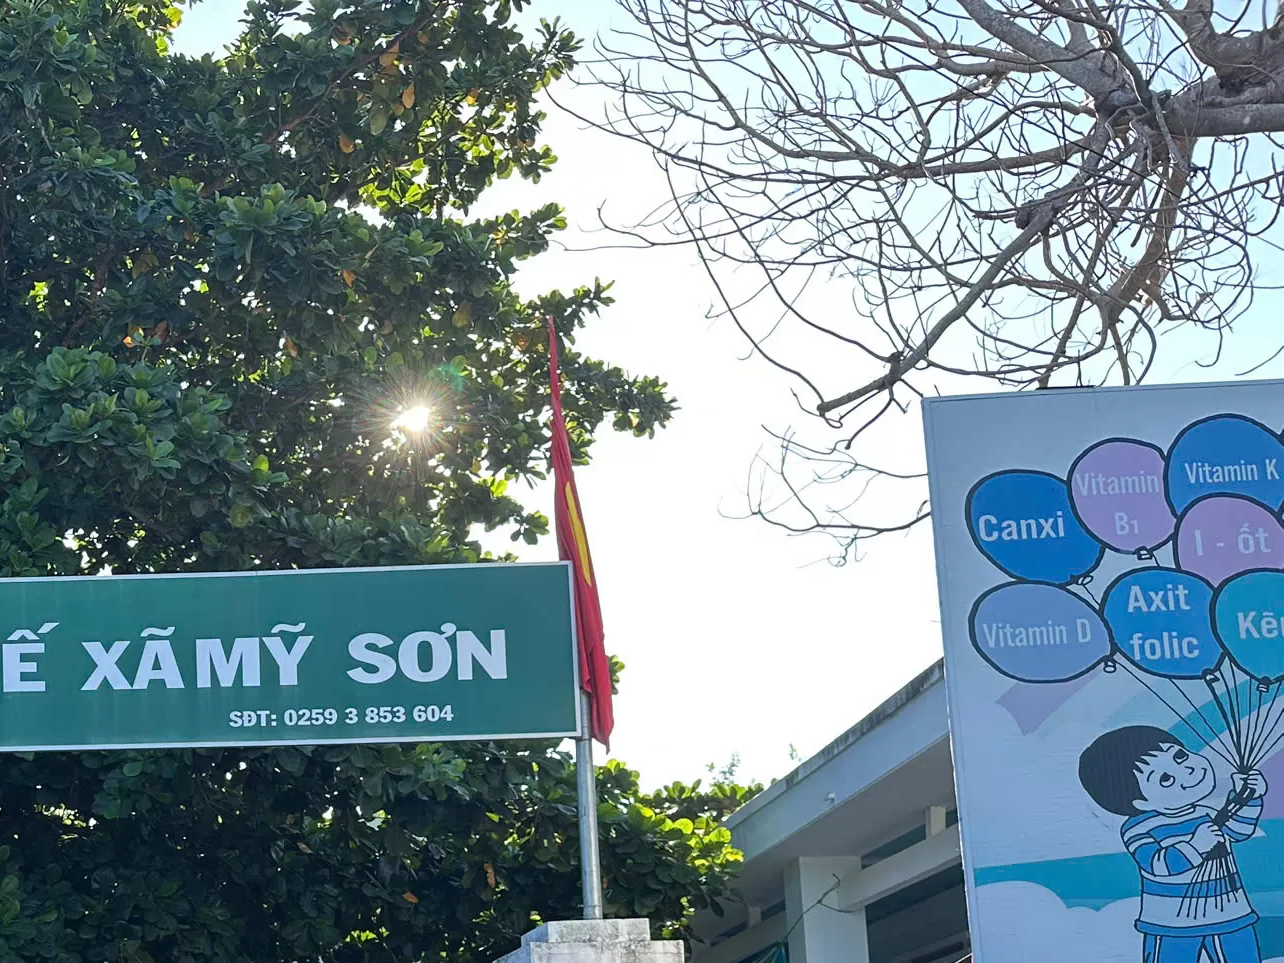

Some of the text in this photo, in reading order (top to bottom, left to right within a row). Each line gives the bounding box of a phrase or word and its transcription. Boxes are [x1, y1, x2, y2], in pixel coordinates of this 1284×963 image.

[1075, 471, 1160, 497] Vitamin
[1184, 458, 1280, 484] Vitamin K
[978, 511, 1065, 542] Canxi
[1114, 512, 1140, 536] B1
[1127, 583, 1191, 613] Axit
[982, 618, 1092, 648] Vitamin D
[1237, 611, 1284, 639] Kẽ
[80, 626, 185, 691] XÃ
[196, 622, 315, 689] MỸ
[346, 622, 508, 685] SƠN
[1129, 631, 1201, 660] folic
[229, 705, 454, 727] SĐT: 0259 3 853 604
